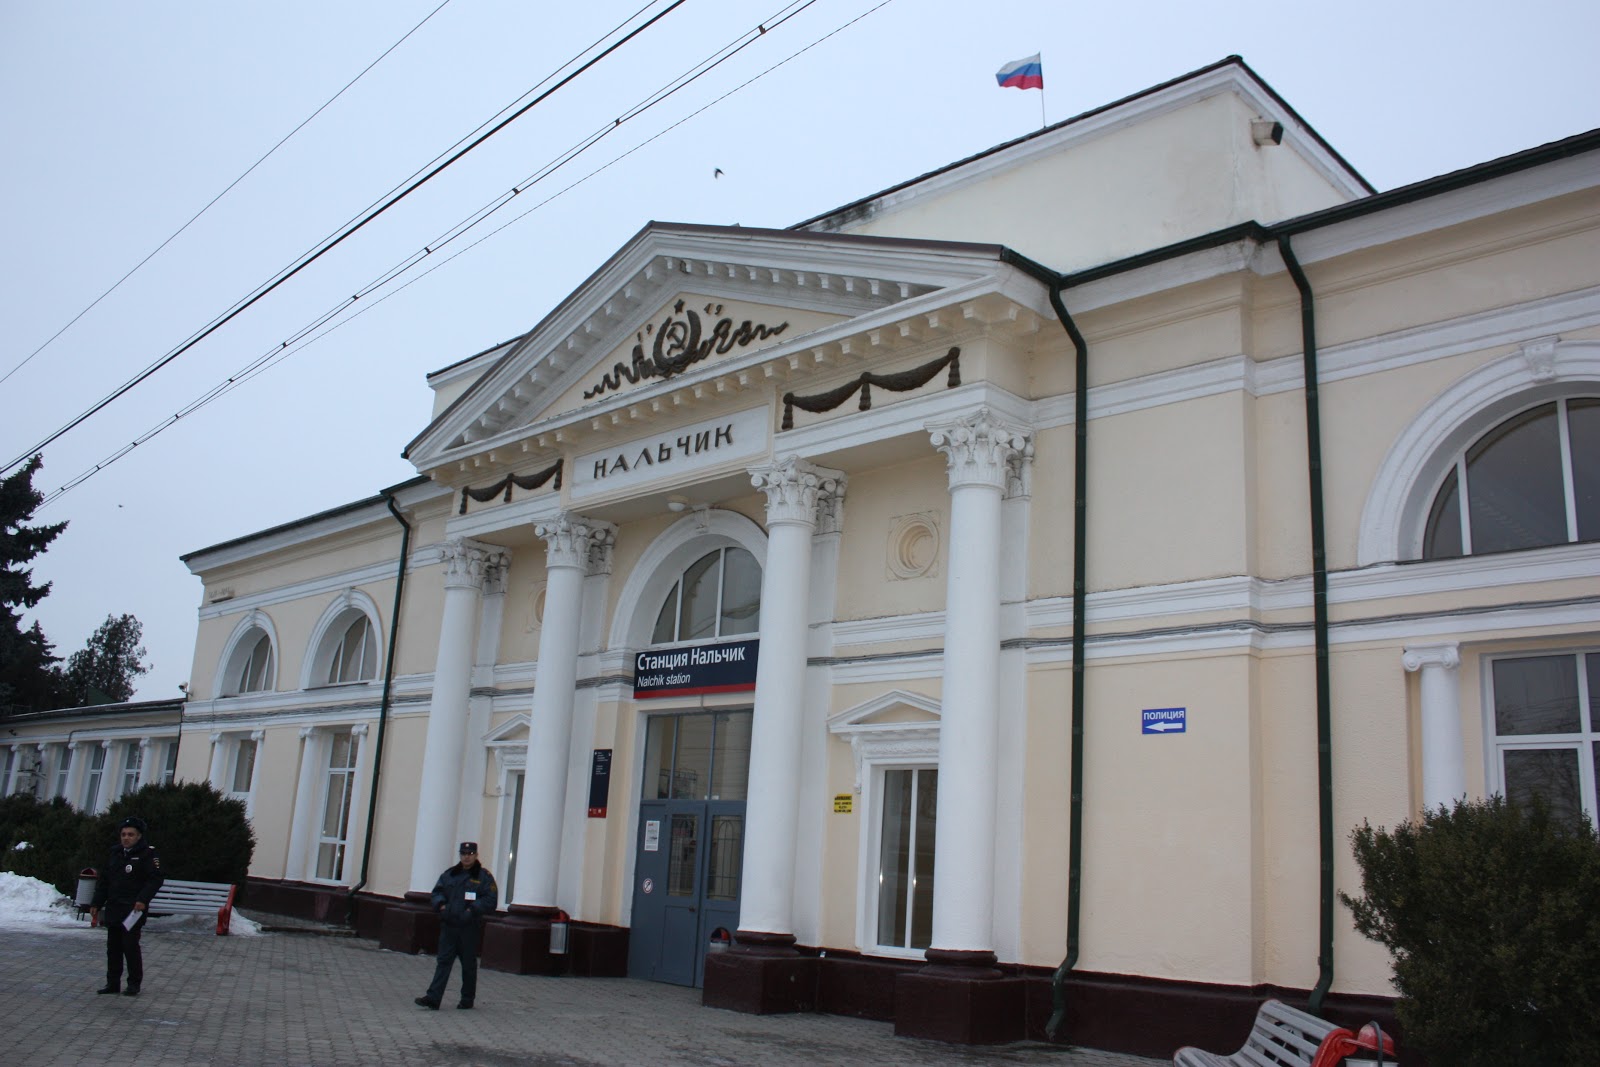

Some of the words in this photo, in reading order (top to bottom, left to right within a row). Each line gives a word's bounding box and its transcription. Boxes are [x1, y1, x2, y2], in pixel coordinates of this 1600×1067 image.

[593, 424, 733, 479] НАЛЬЧИК
[637, 652, 688, 671] Станция
[690, 646, 746, 665] Нальчик
[637, 674, 665, 687] Nalchik
[665, 672, 691, 685] station
[1143, 710, 1185, 721] ПОЛИЦИЯ
